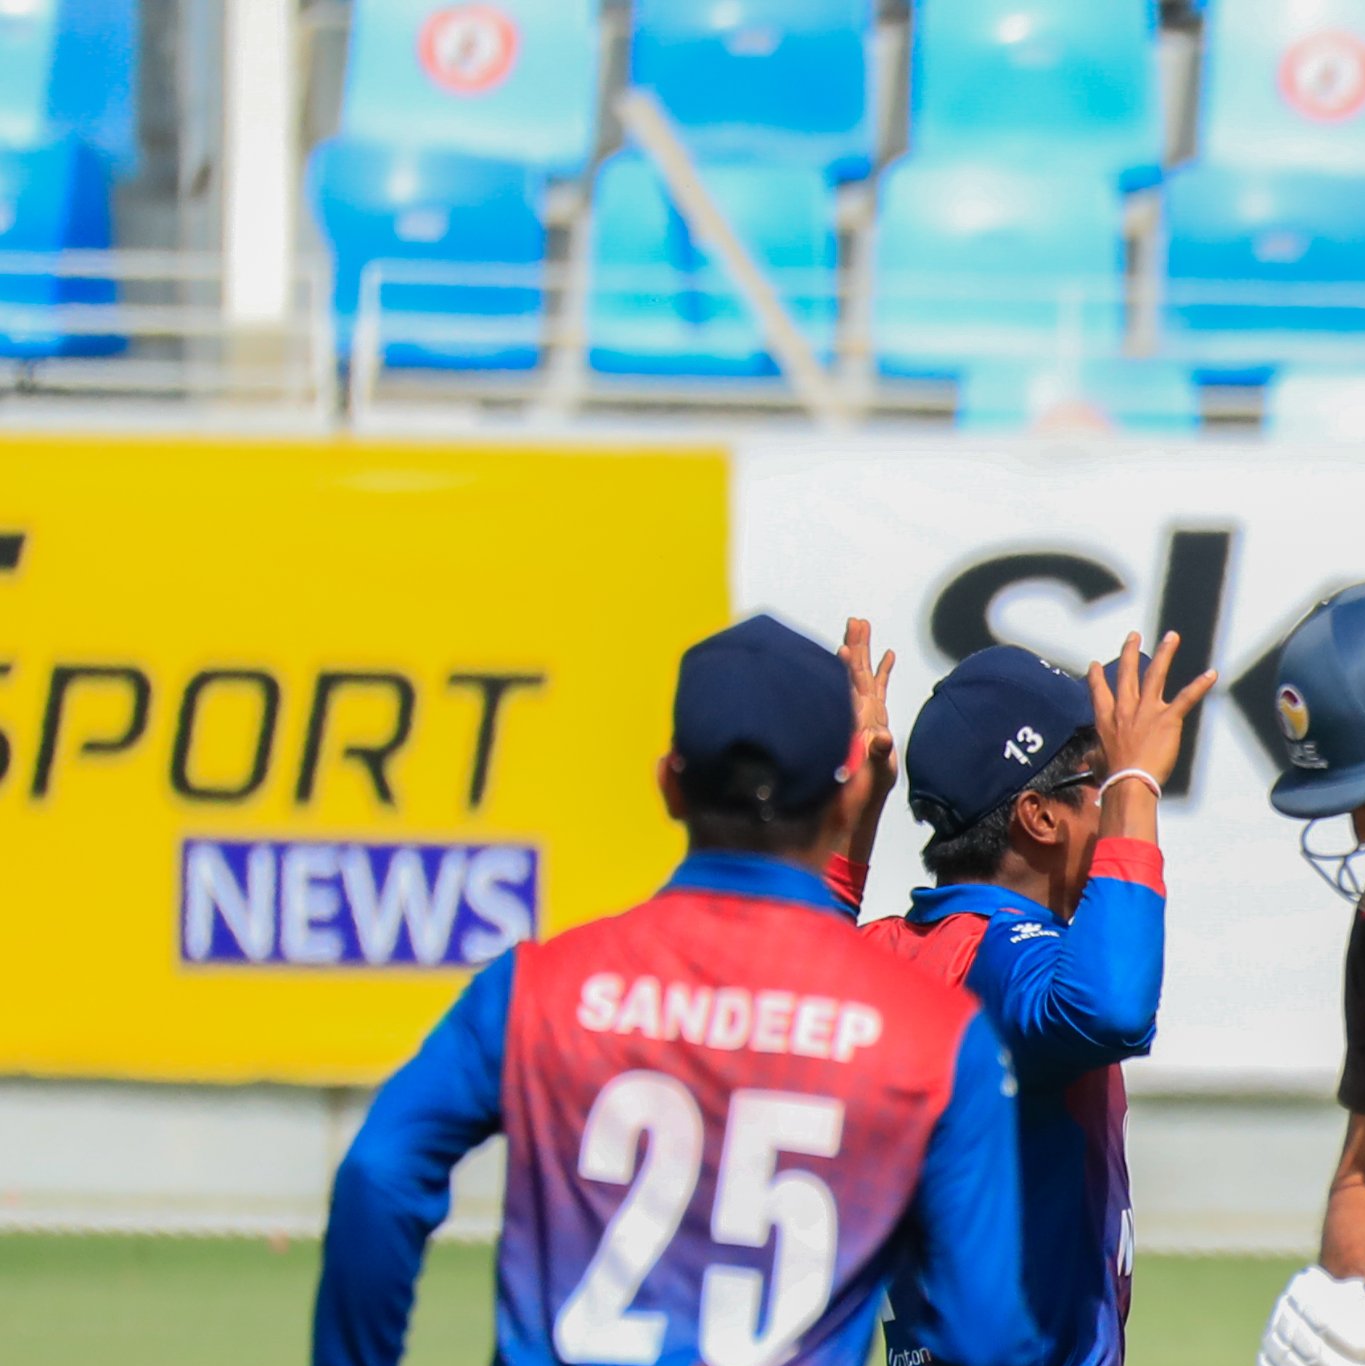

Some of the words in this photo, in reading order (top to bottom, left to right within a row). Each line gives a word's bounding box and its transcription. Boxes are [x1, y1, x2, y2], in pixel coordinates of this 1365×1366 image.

[0, 660, 546, 810] PORT
[1003, 726, 1044, 766] 13
[184, 842, 534, 965] NEWS
[577, 972, 884, 1063] SANDEEP
